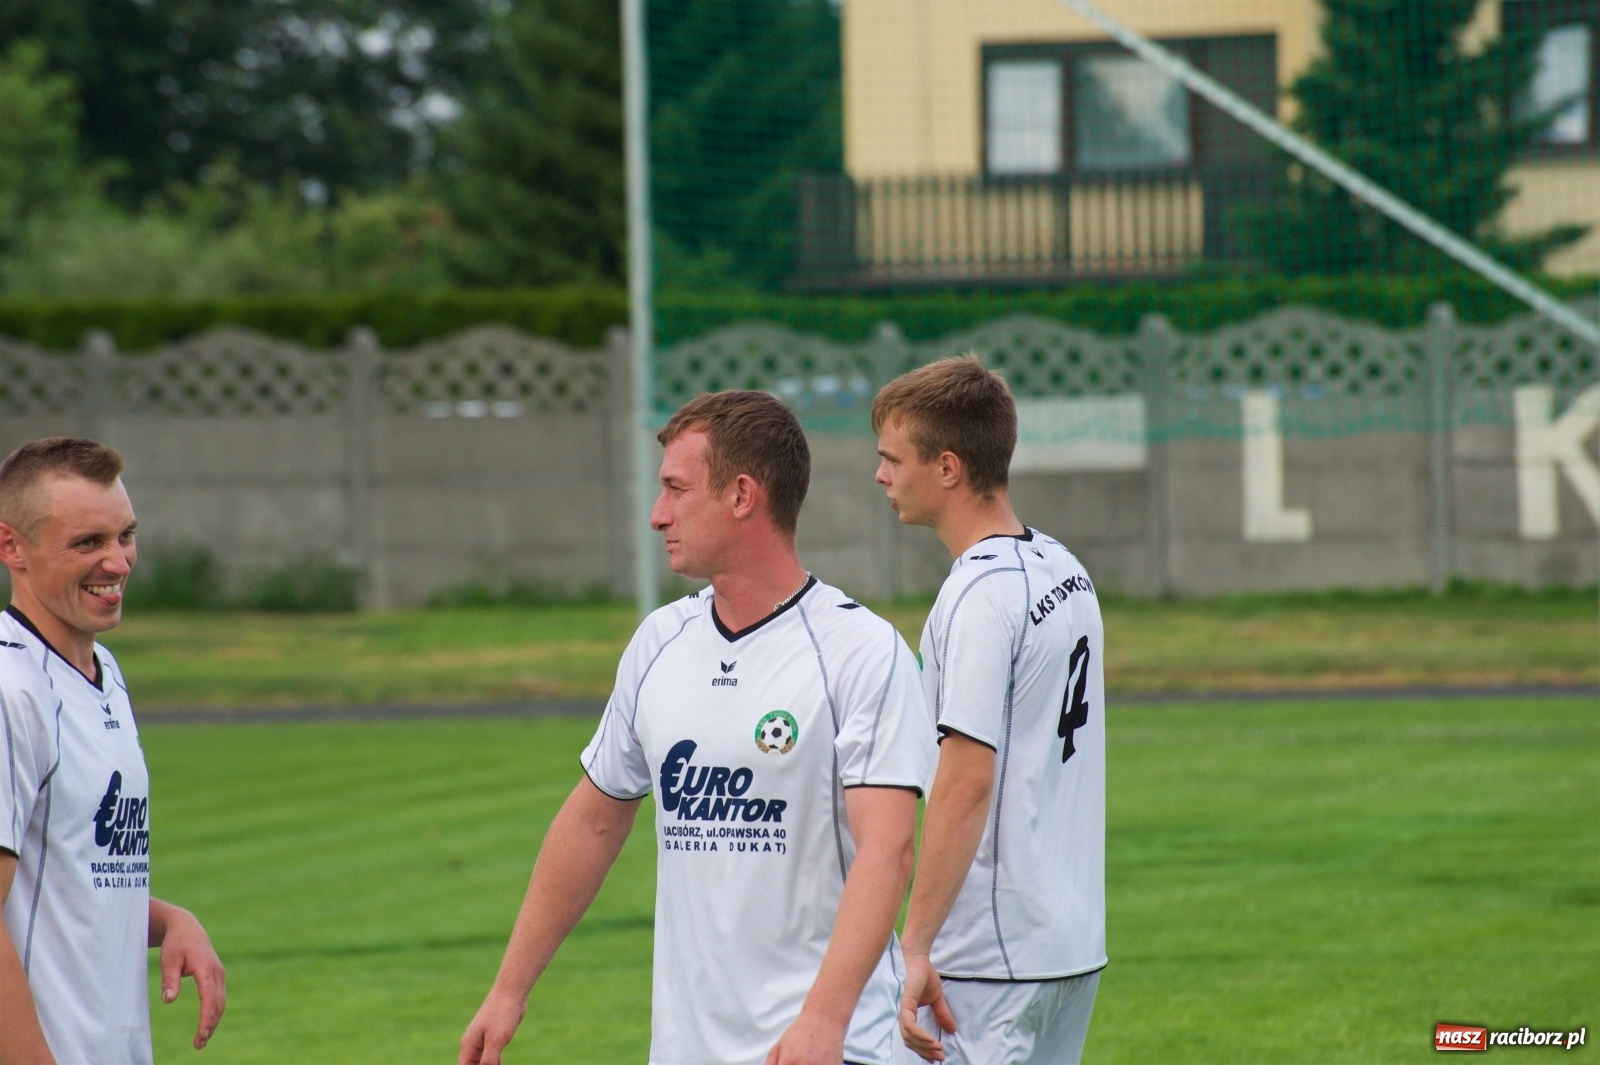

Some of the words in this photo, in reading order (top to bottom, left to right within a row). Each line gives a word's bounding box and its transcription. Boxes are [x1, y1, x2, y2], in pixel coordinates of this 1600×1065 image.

[1241, 388, 1312, 541] L
[1513, 384, 1600, 540] K
[1029, 594, 1055, 626] LKS
[712, 676, 738, 687] erima
[1058, 635, 1090, 764] 4
[104, 718, 120, 729] erima
[677, 796, 787, 822] KANTOR
[108, 830, 149, 856] KANTO
[773, 828, 786, 839] 40
[729, 842, 786, 855] DUKAT)
